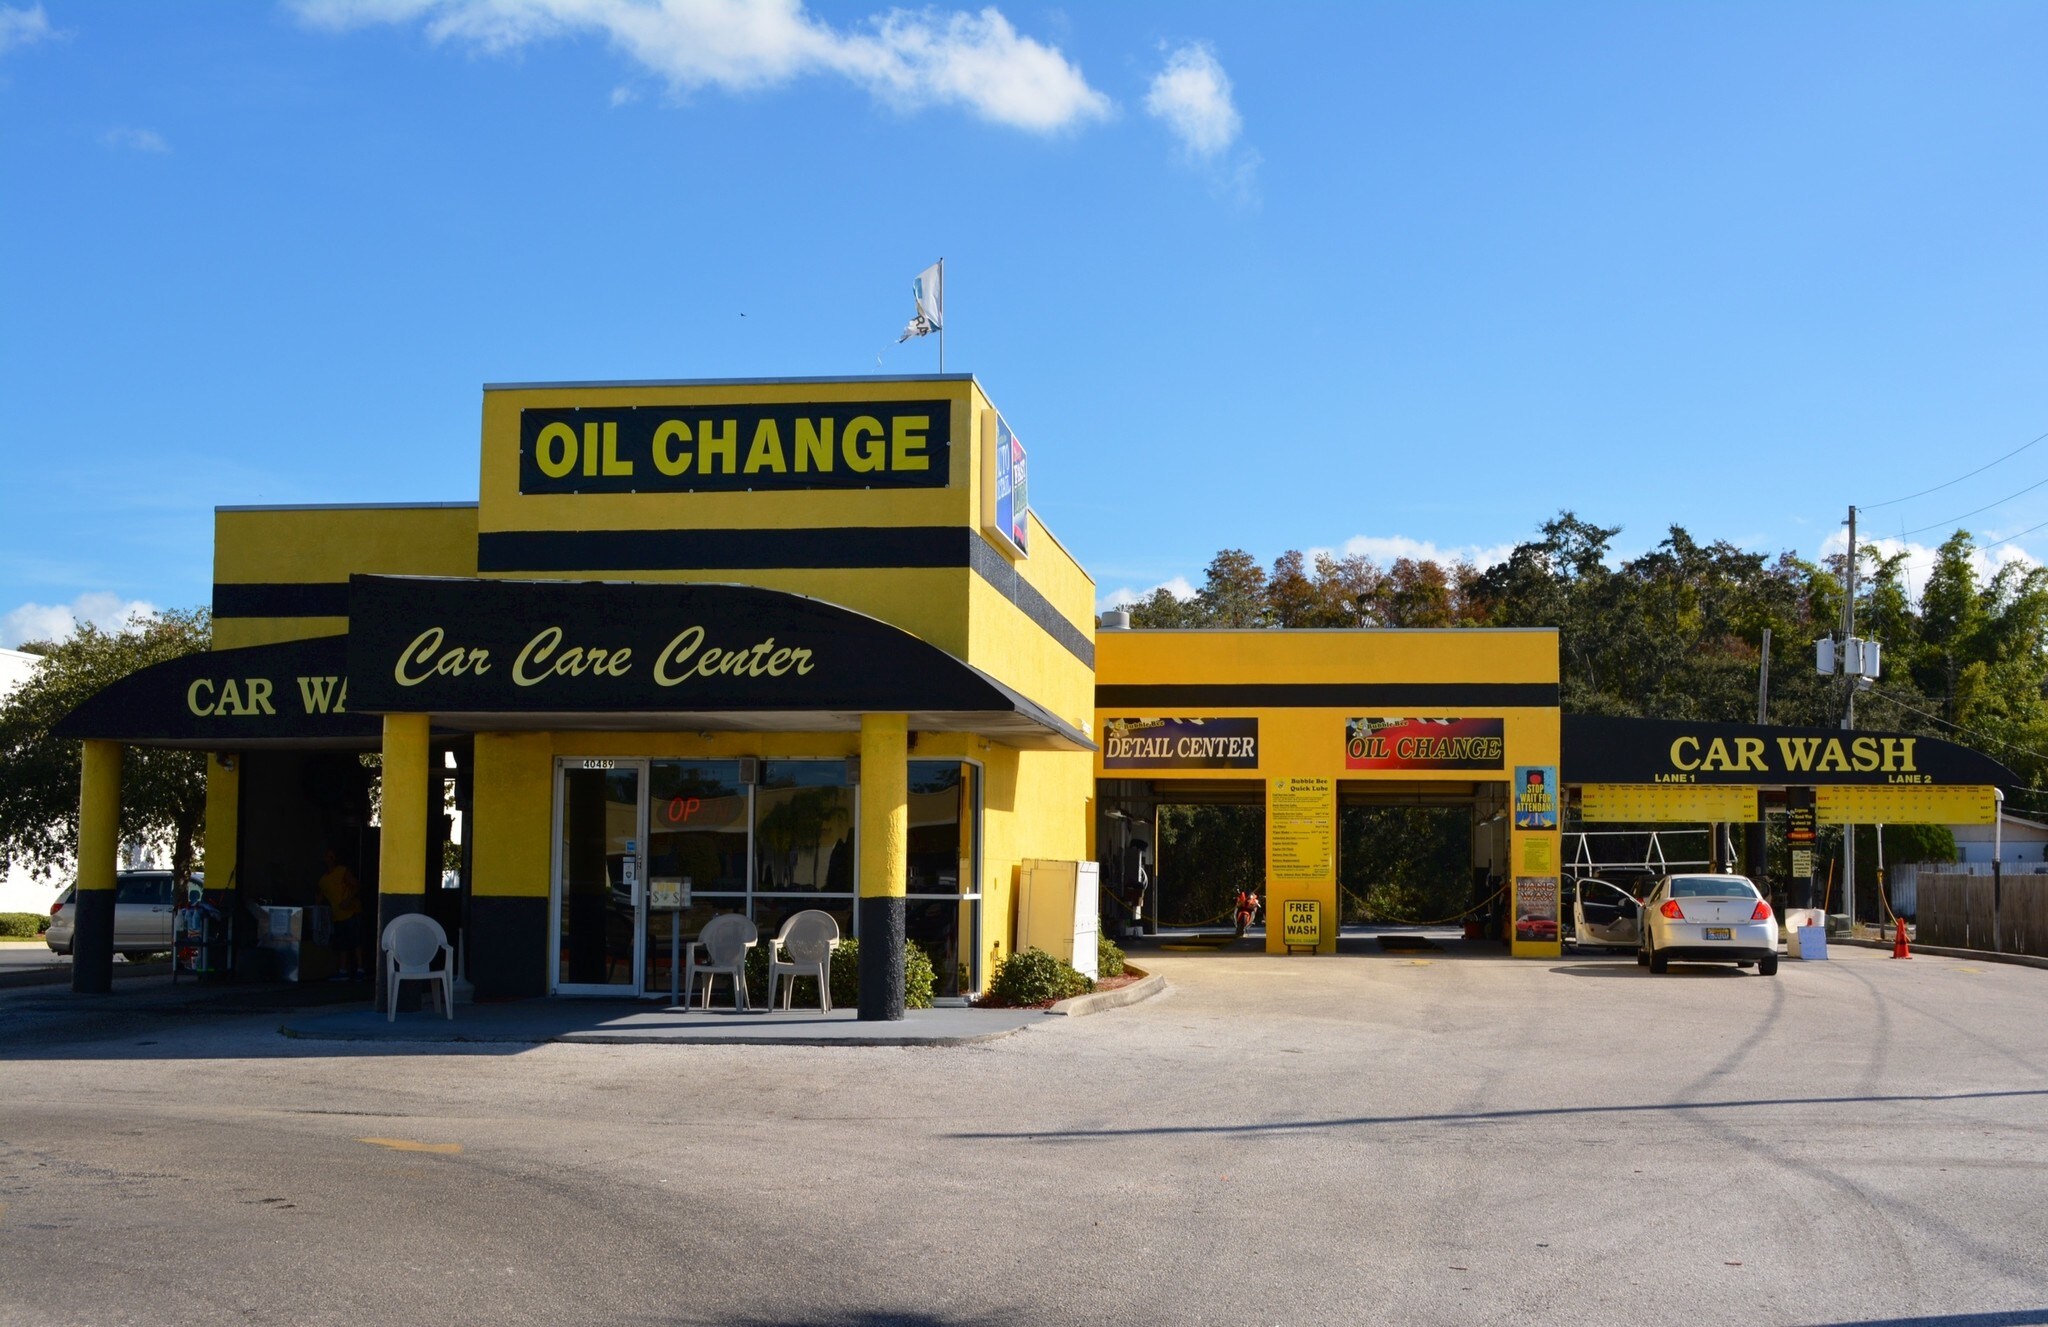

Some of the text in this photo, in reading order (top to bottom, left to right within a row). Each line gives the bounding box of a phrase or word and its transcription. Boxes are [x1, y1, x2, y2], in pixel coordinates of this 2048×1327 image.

[535, 415, 930, 479] OIL CHANGE
[395, 626, 815, 687] Car Care Center
[187, 676, 348, 717] CAR WA
[1106, 737, 1255, 758] DETAIL CENTER
[1347, 737, 1502, 759] OIL CHANGE
[1670, 736, 1916, 772] CAR WASH
[583, 760, 615, 769] 40489
[1654, 774, 1696, 782] LANE 1
[1888, 775, 1932, 783] LANE 2
[1527, 784, 1544, 793] STOP
[1519, 793, 1552, 803] WAIT FOR
[1516, 802, 1554, 812] ATTENDANT
[1517, 882, 1555, 891] HAND
[1519, 891, 1553, 901] WAX
[1289, 903, 1315, 912] FREE
[1291, 914, 1313, 924] CAR
[1287, 925, 1317, 935] WASH
